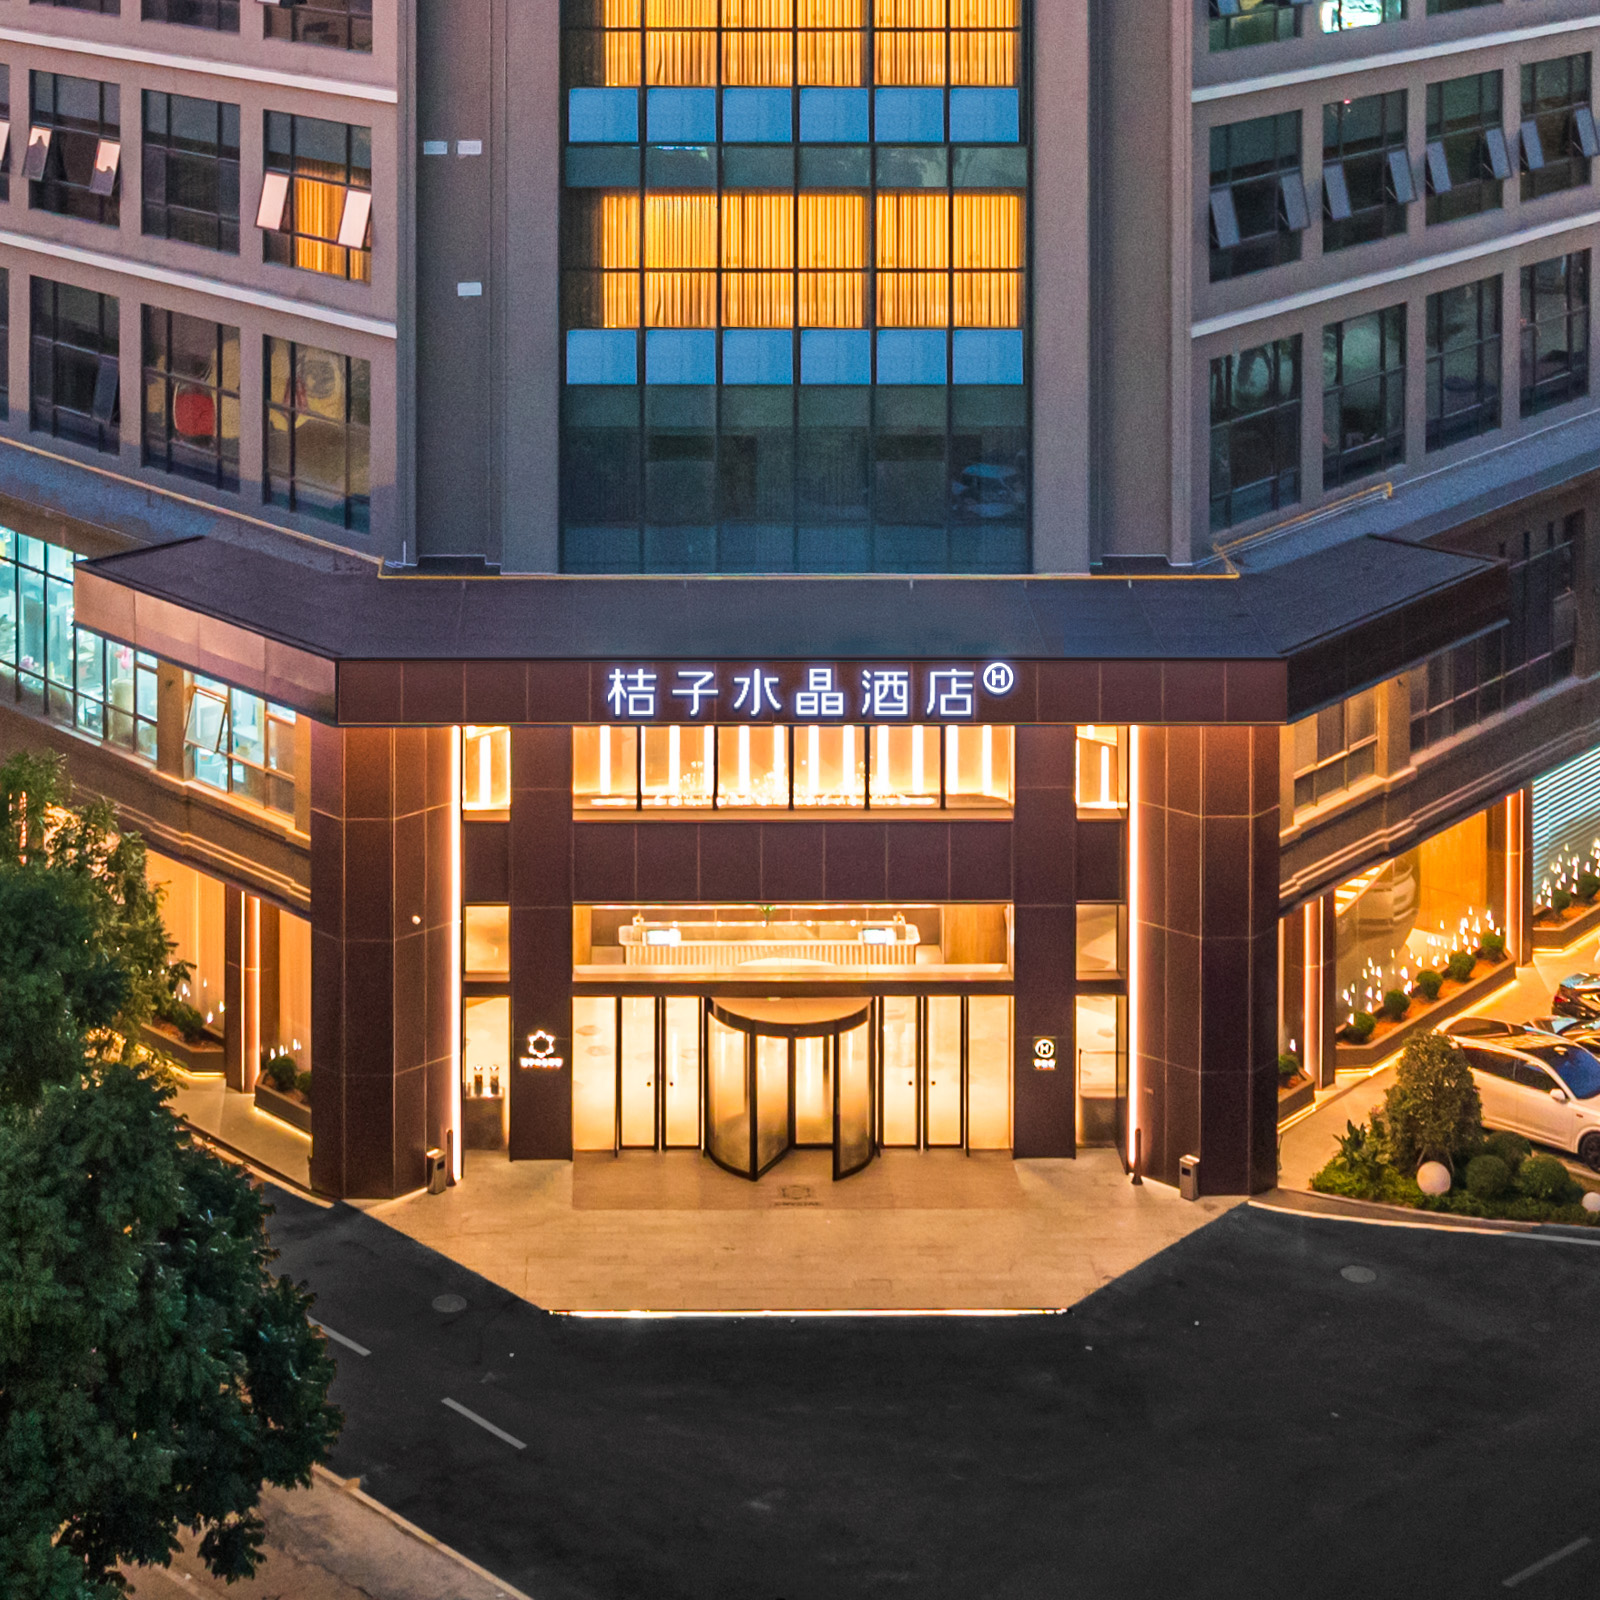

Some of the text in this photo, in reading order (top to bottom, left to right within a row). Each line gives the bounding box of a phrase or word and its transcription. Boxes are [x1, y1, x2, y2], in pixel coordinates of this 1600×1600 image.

[608, 668, 974, 717] 桔子水晶酒店
